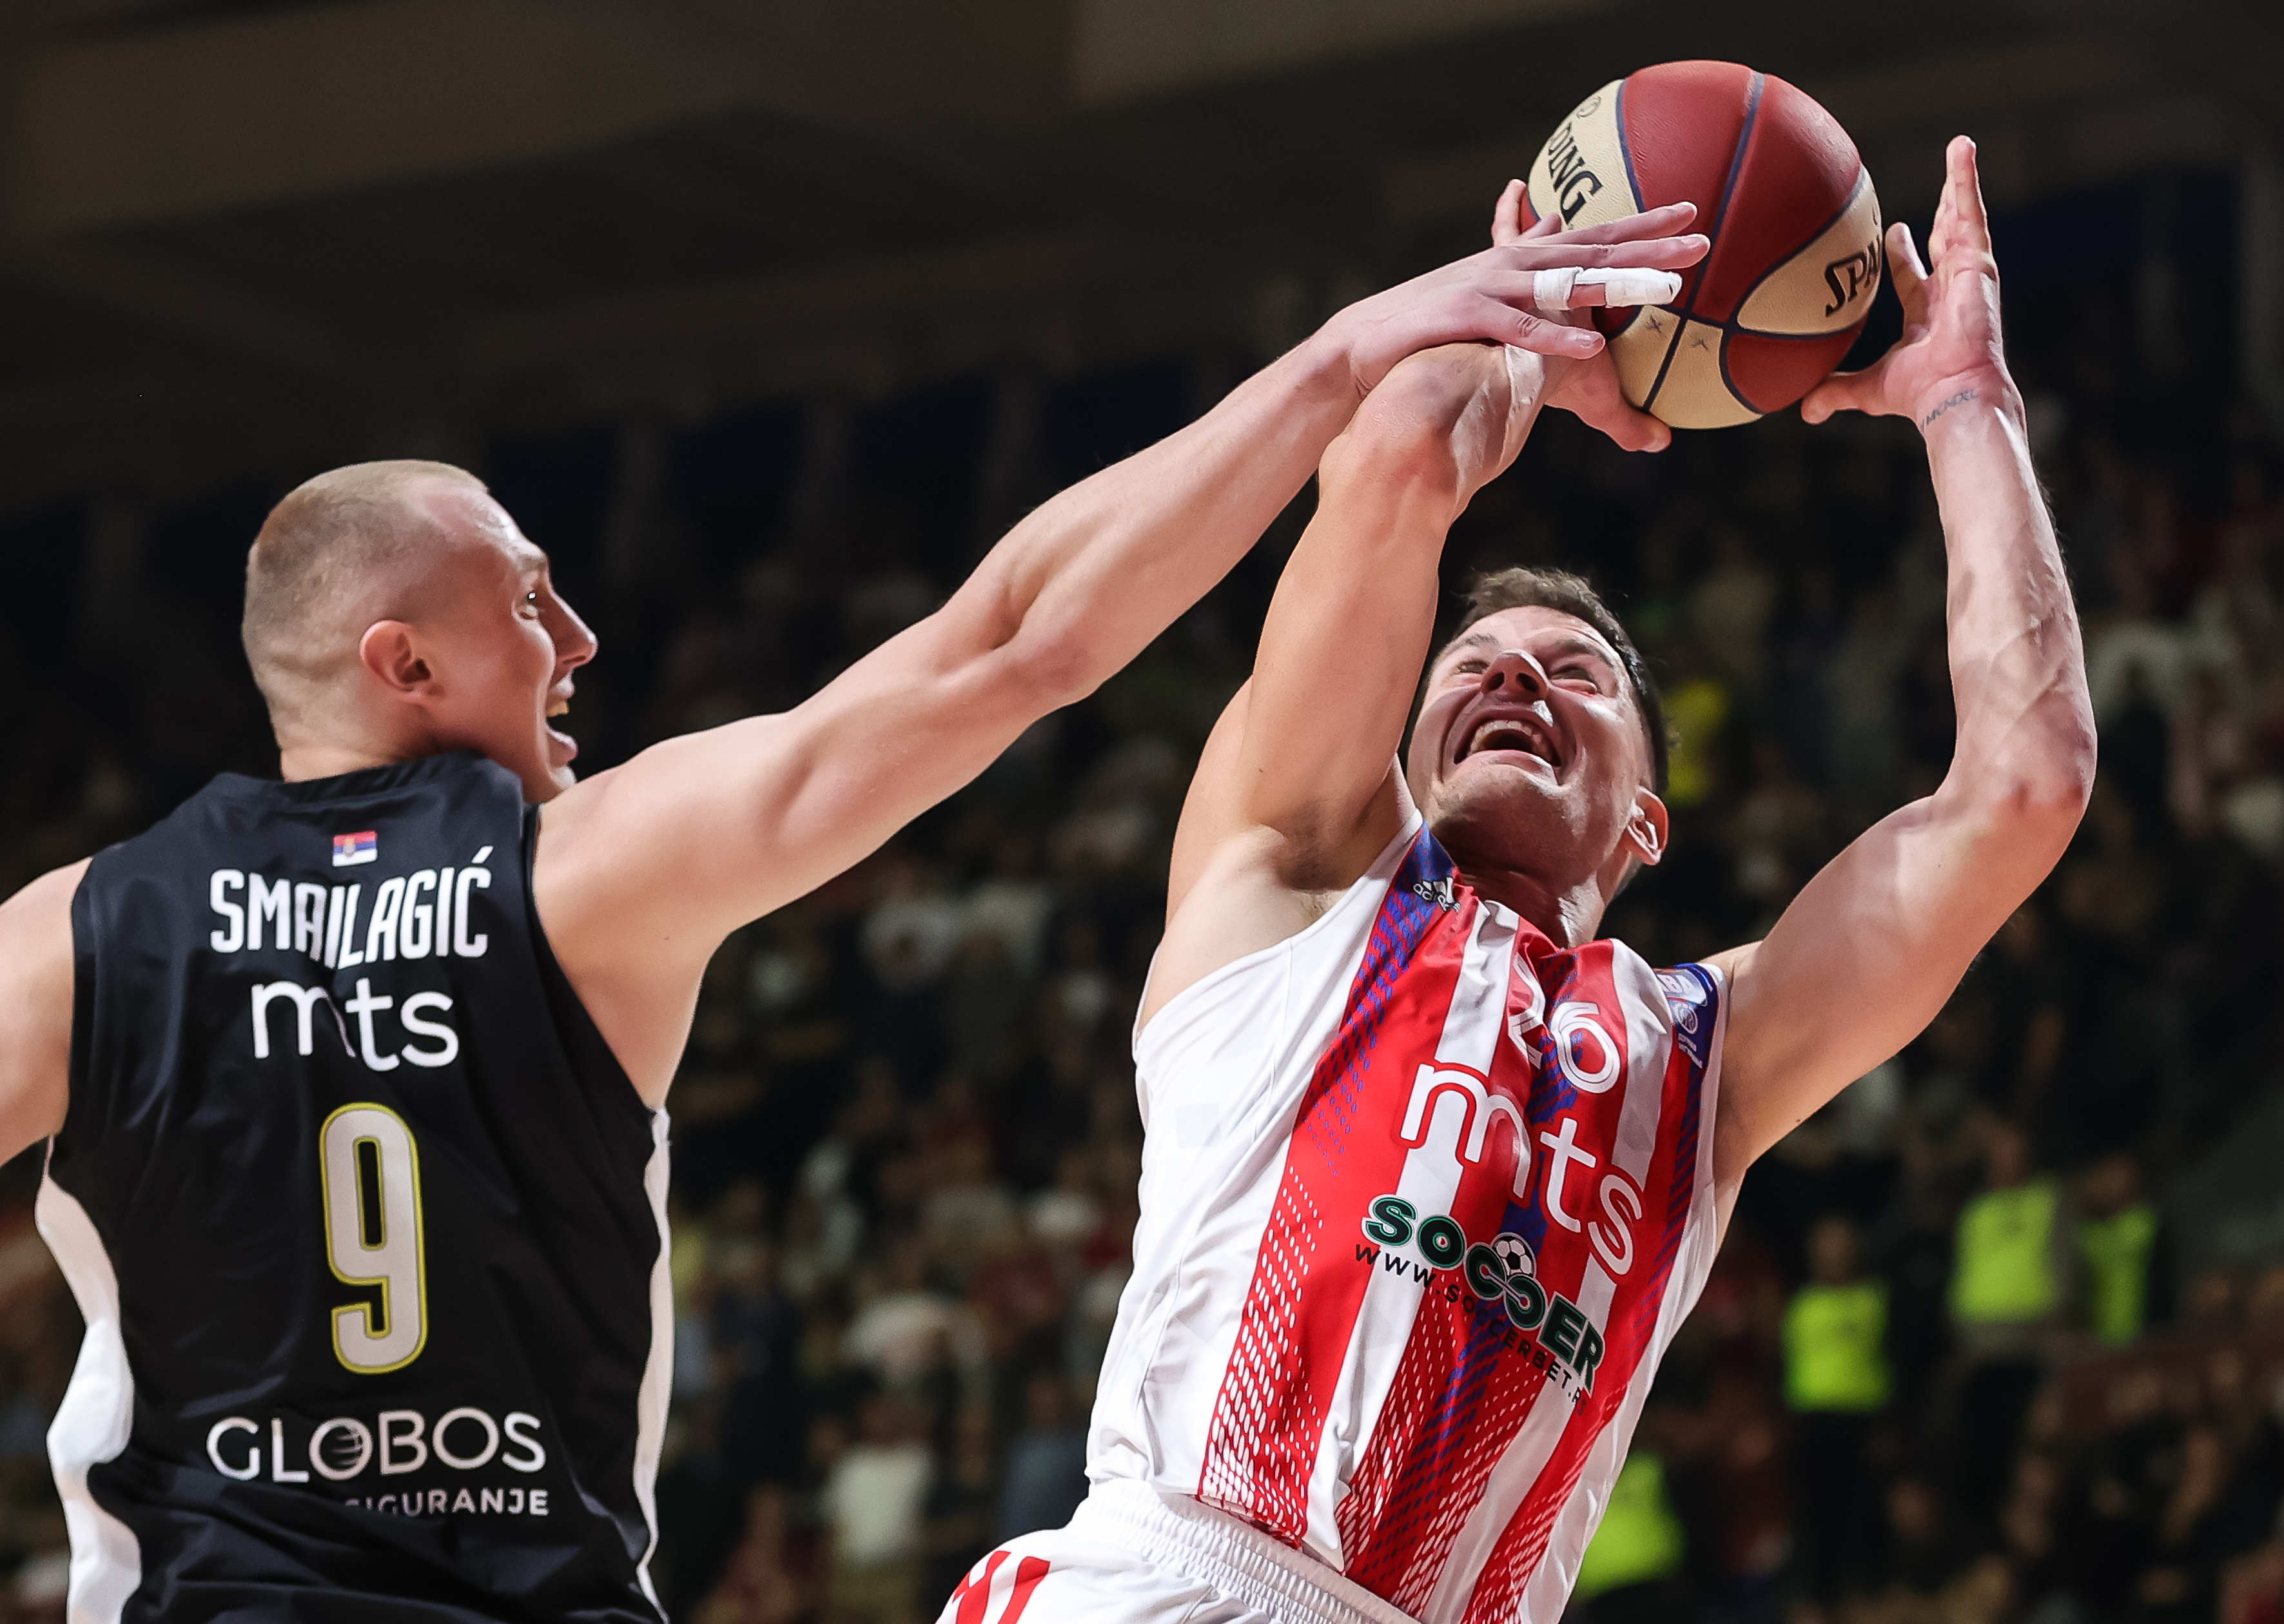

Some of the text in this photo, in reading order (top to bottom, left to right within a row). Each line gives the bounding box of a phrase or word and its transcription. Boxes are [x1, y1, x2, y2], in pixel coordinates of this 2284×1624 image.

[210, 846, 493, 969] SMAILAGIĆ
[251, 976, 459, 1071] mts
[1400, 1064, 1643, 1275] mts
[319, 1102, 428, 1374] 9
[206, 1407, 547, 1483] GLOBOS
